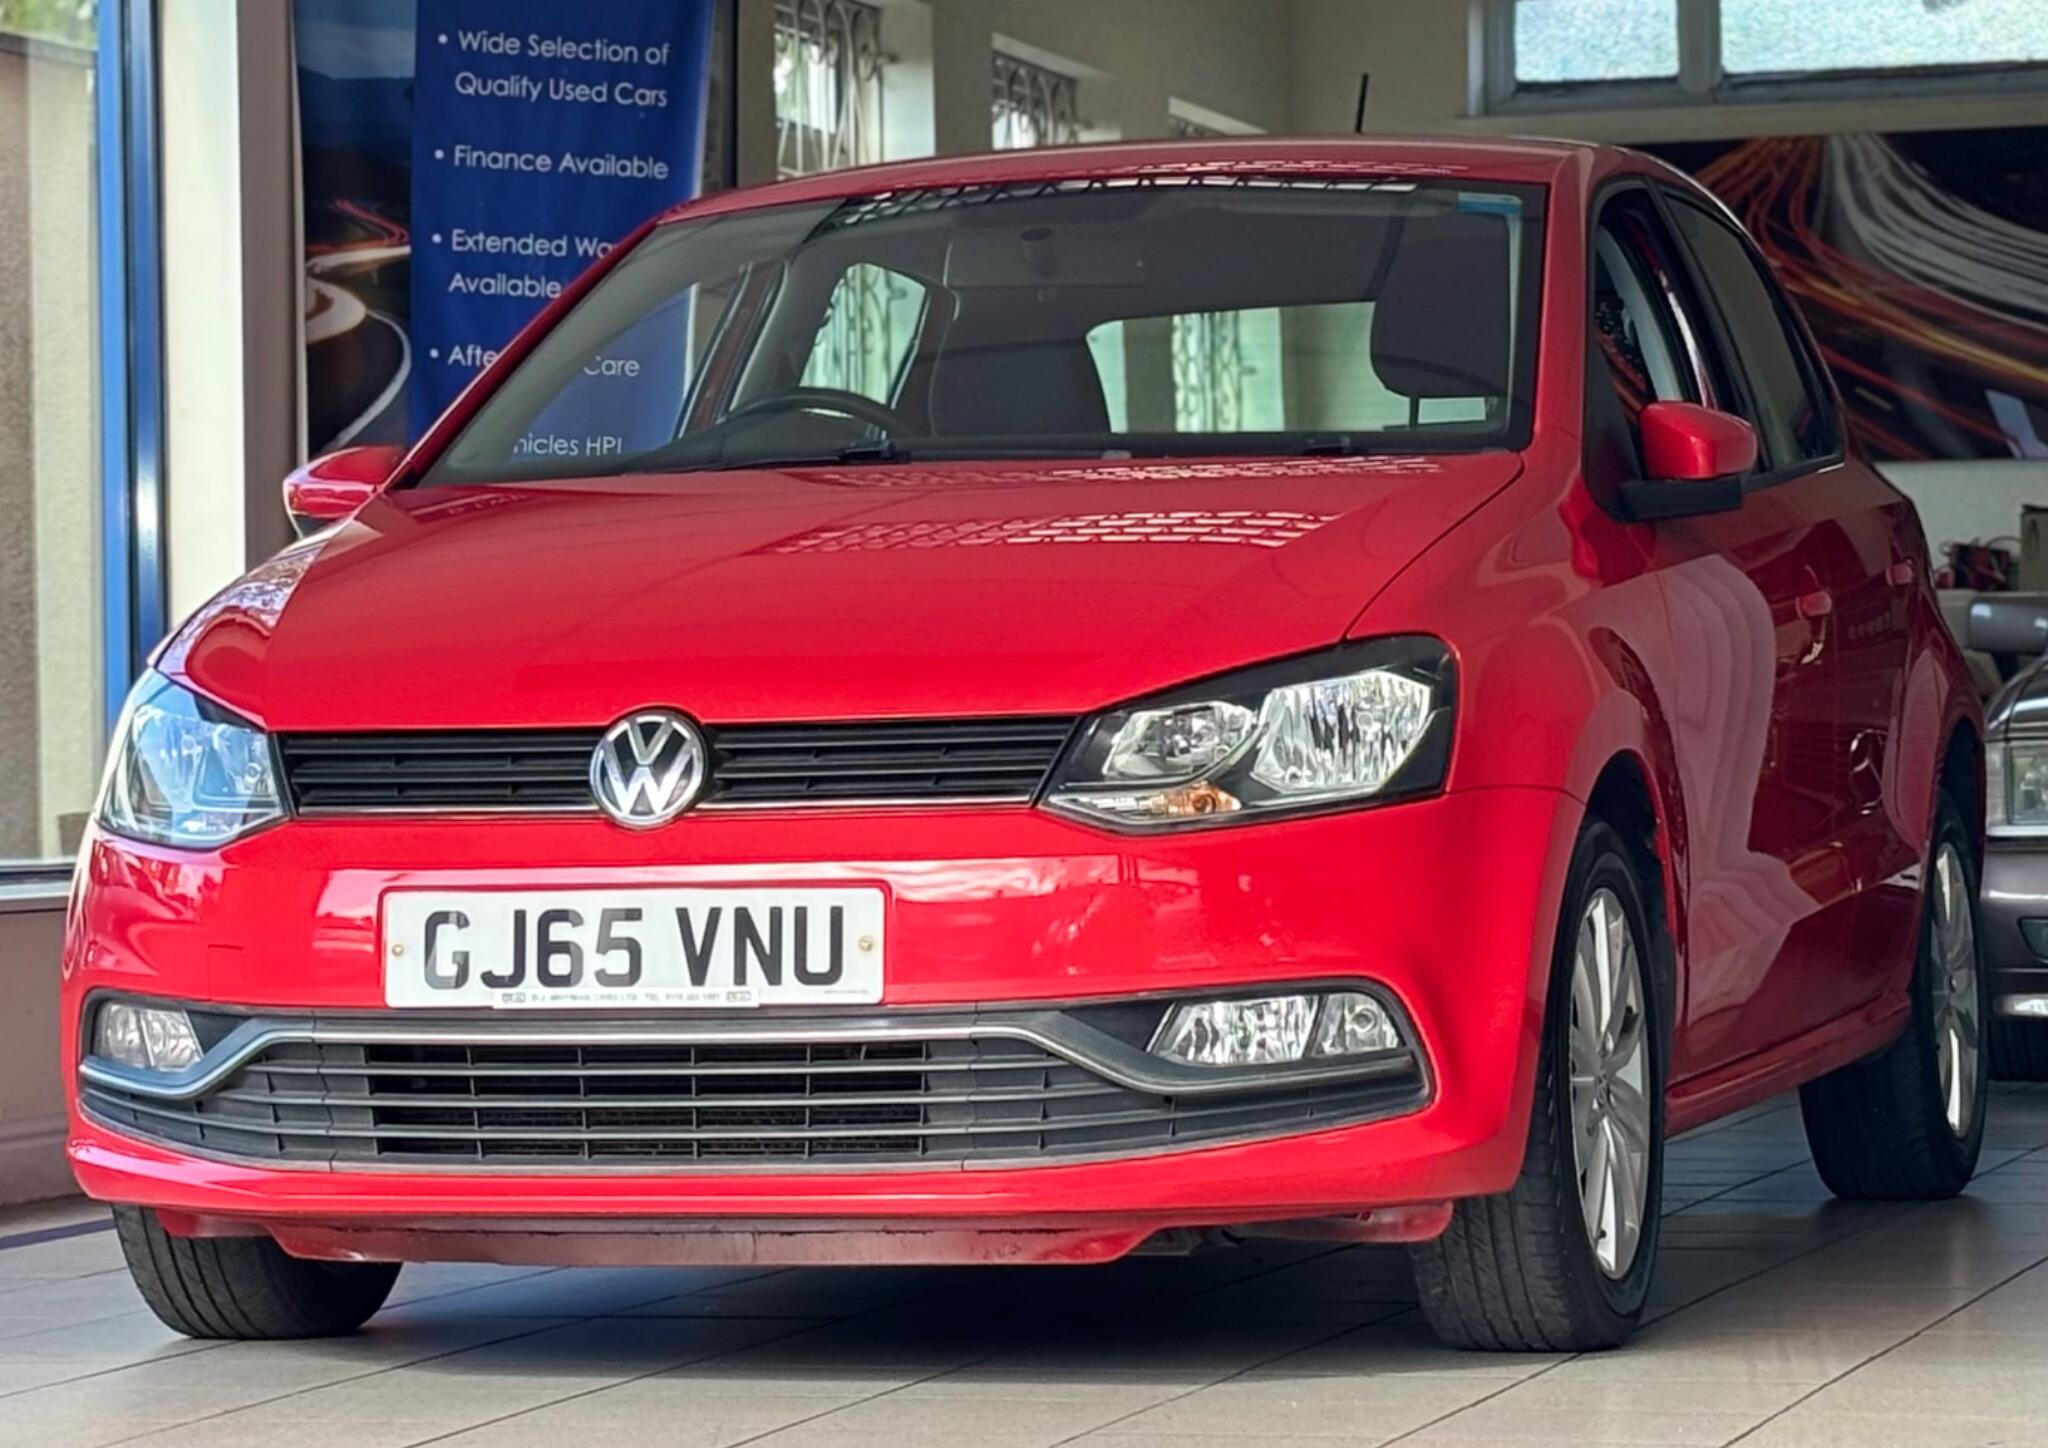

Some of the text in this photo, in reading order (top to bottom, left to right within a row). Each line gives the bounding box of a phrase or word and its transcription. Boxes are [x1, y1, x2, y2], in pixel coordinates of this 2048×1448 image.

[457, 30, 669, 65] Wide Selection of
[454, 72, 668, 107] Quality Used Cars
[453, 145, 669, 179] Finance Available
[451, 228, 568, 257] Extended
[447, 272, 563, 298] Available
[585, 436, 623, 456] HPI
[424, 905, 845, 990] GJ65 VNU
